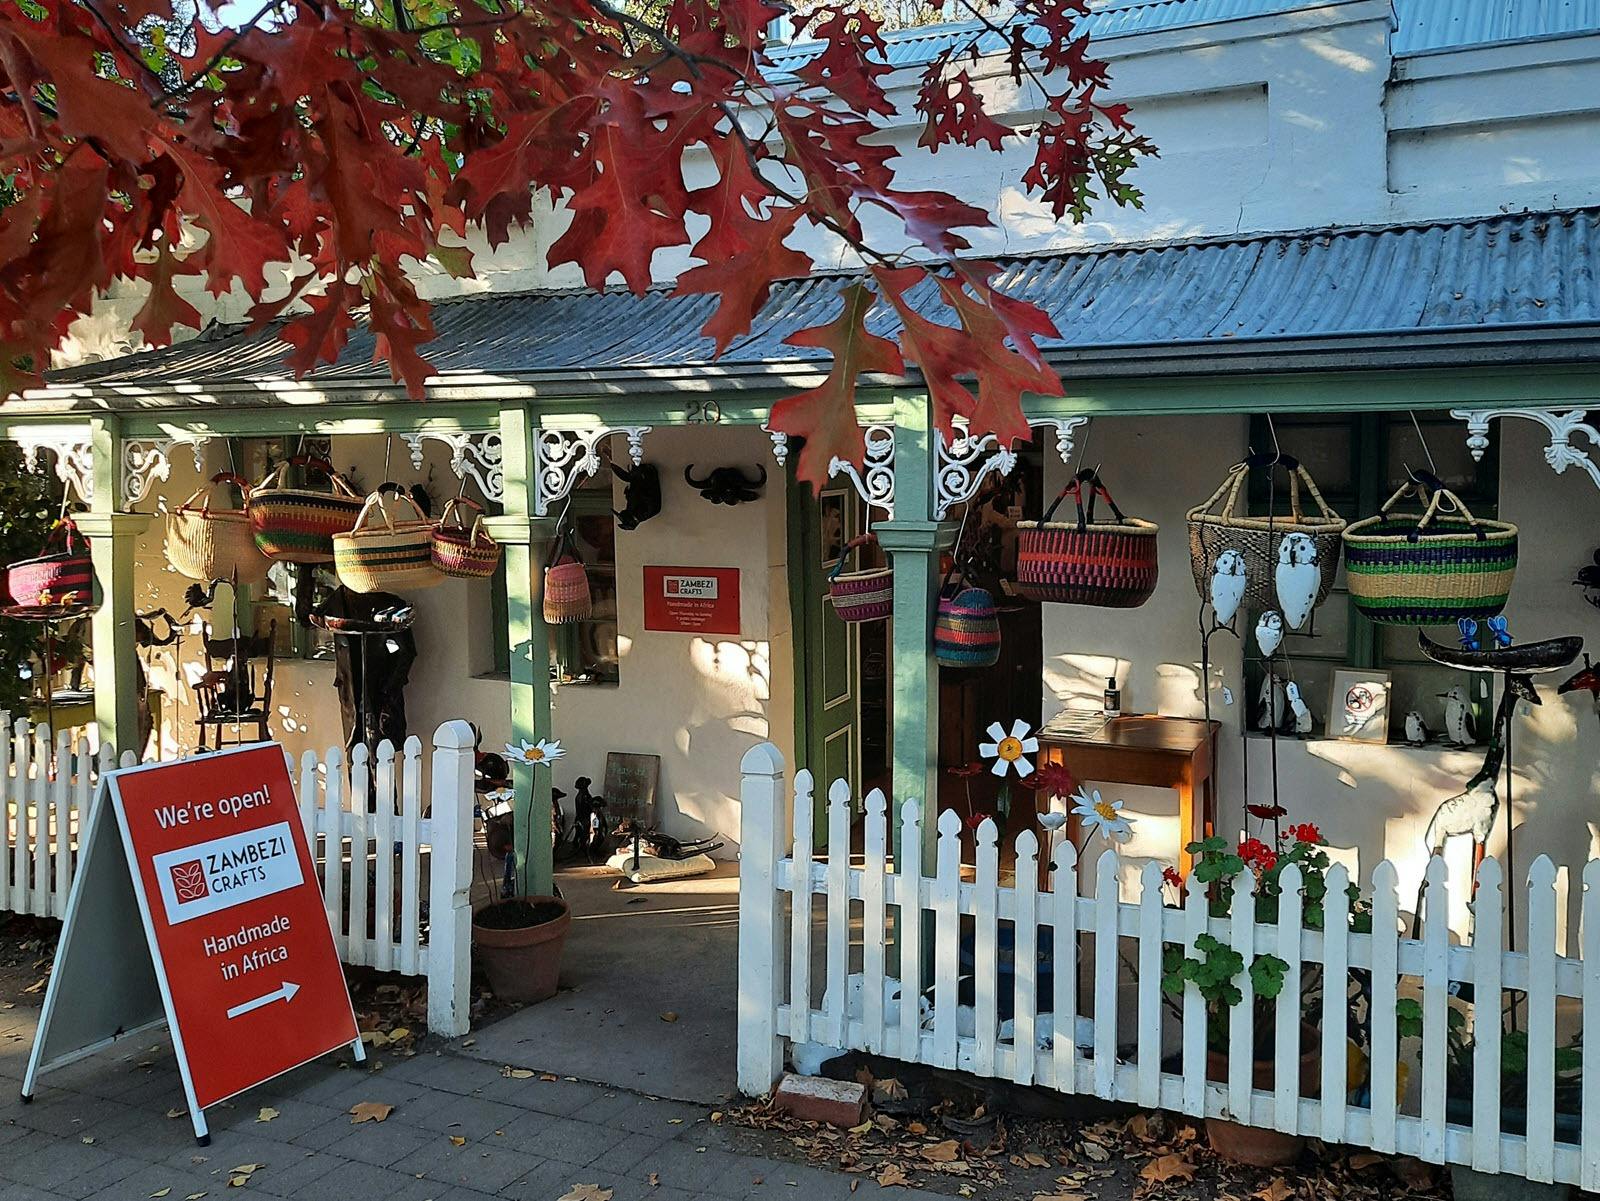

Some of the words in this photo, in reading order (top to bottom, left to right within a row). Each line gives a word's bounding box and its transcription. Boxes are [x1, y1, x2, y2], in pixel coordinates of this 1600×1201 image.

[686, 400, 720, 424] 20
[680, 580, 713, 588] ZAMBEZI
[154, 800, 215, 830] We're
[218, 784, 271, 818] open!
[206, 837, 287, 875] ZAMBEZI
[211, 865, 267, 894] CRAFTS
[203, 915, 291, 957] Handmade
[221, 962, 239, 981] in
[242, 945, 289, 976] Africa
